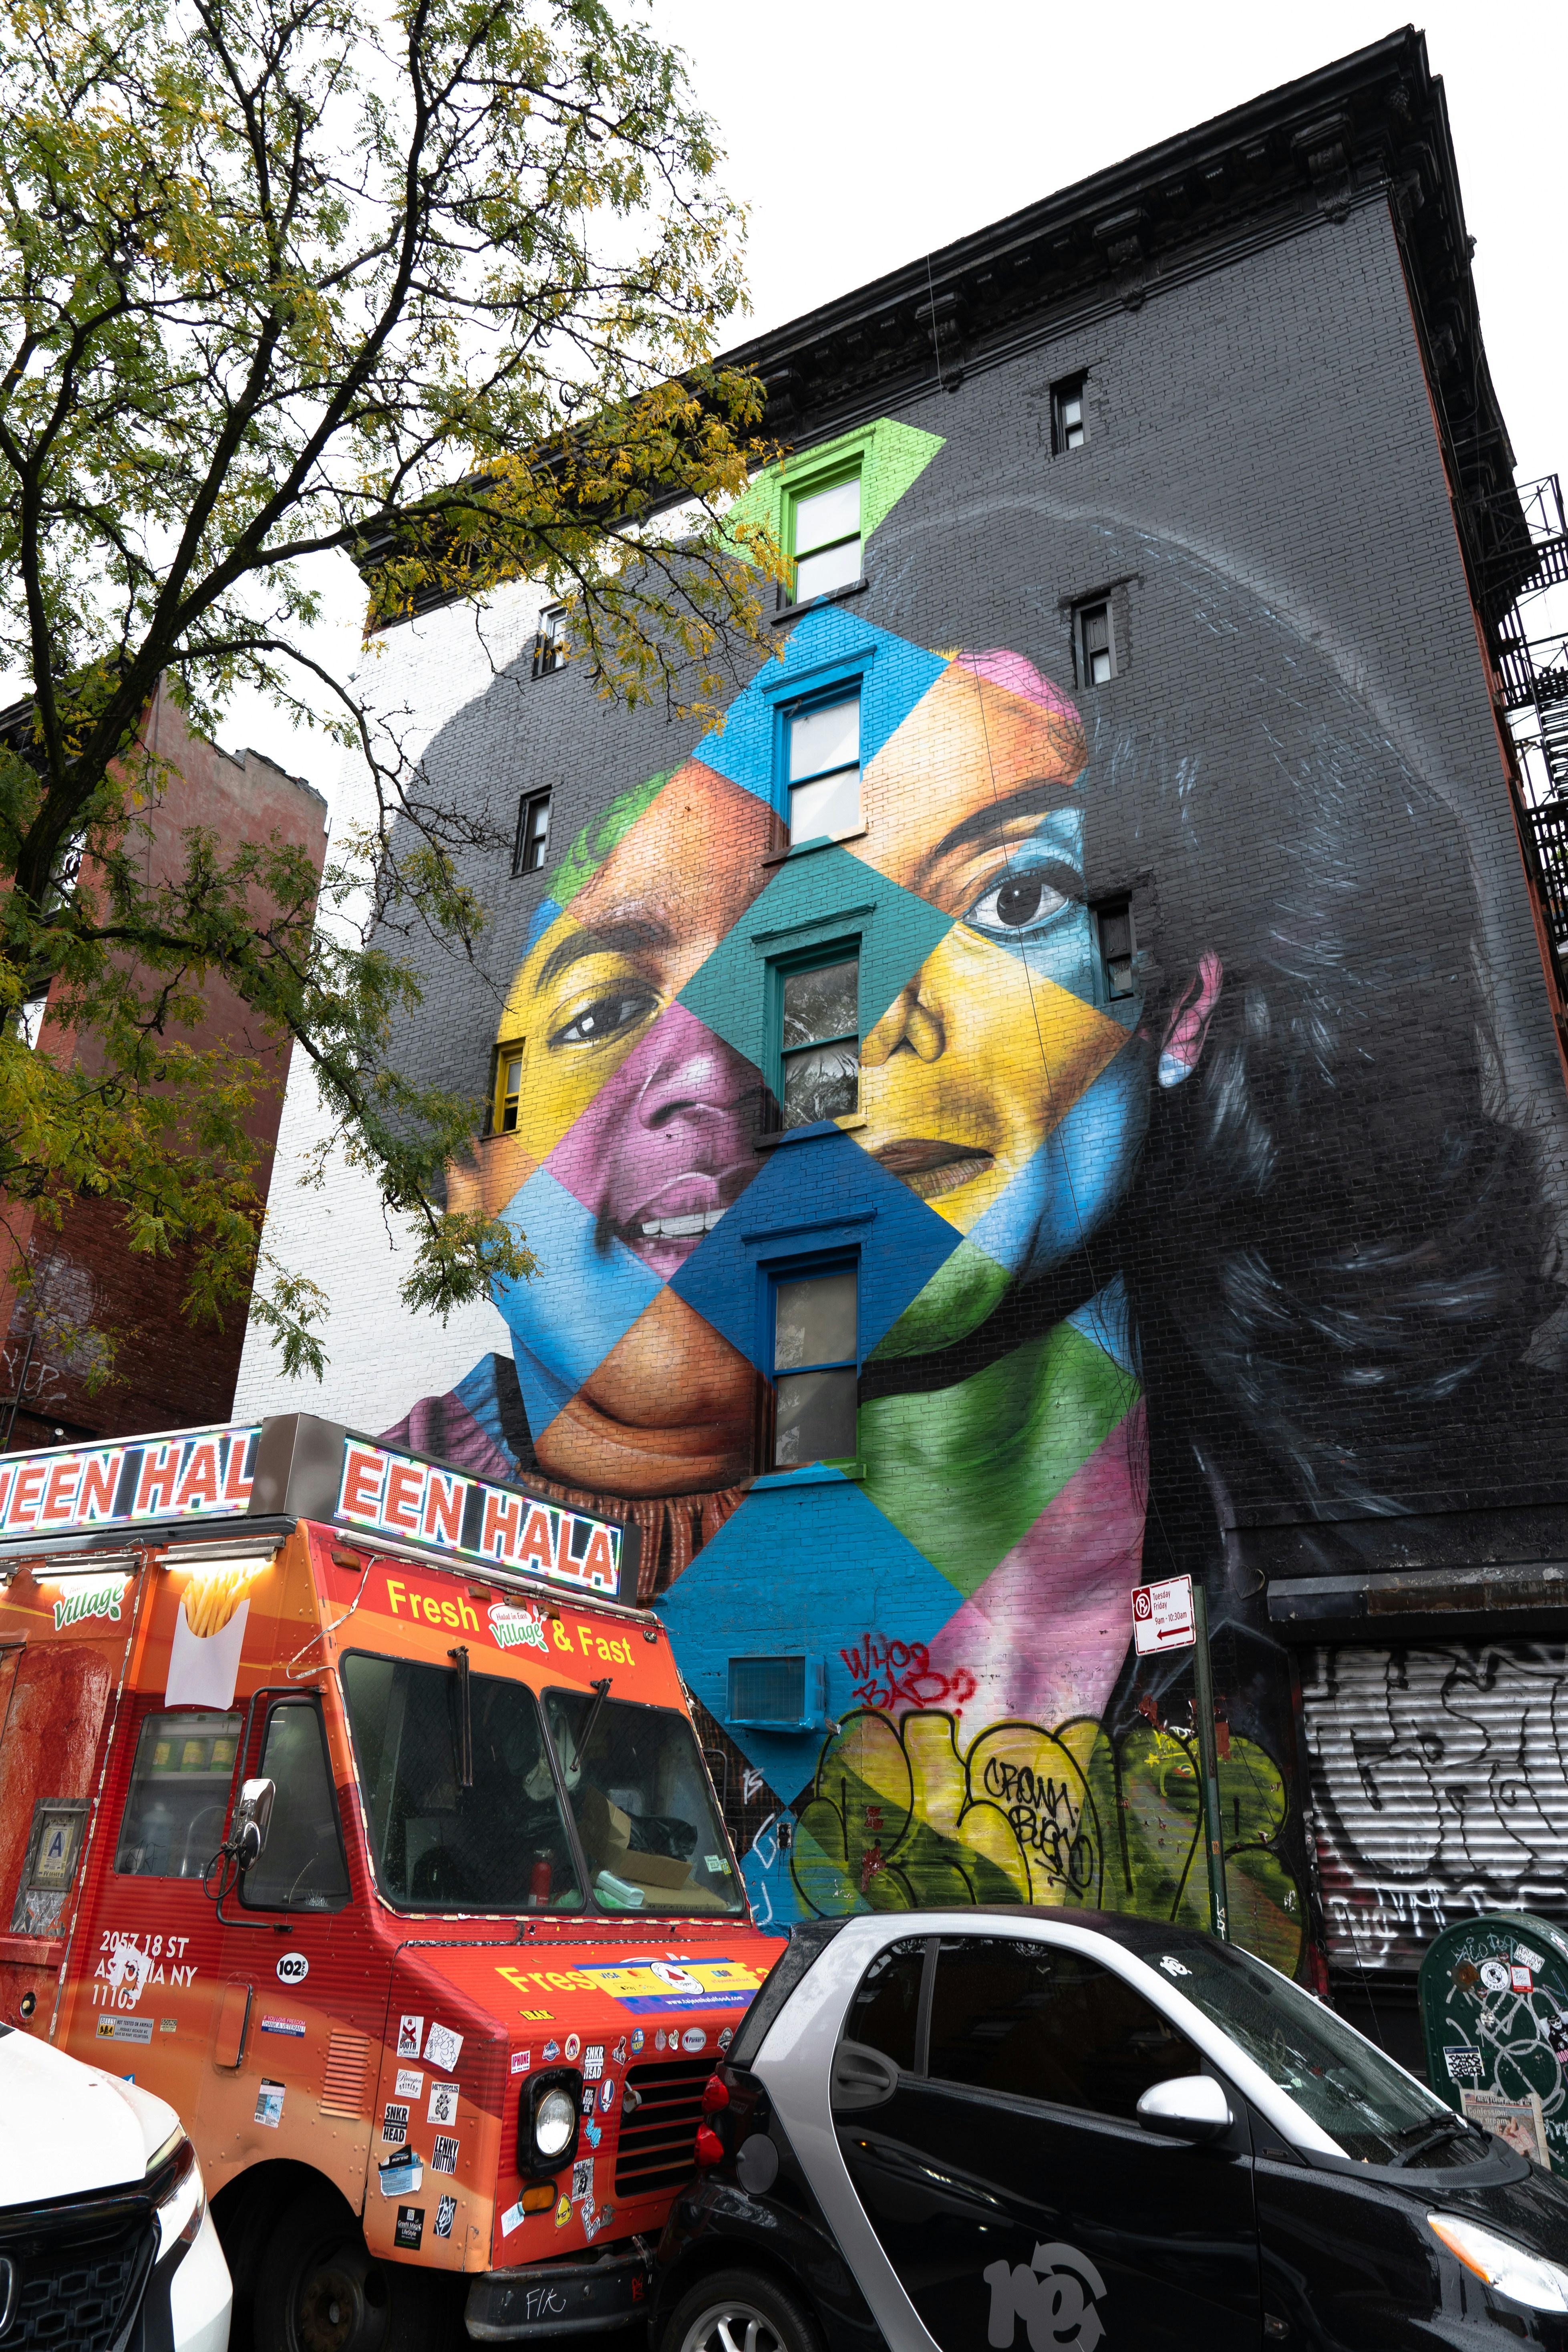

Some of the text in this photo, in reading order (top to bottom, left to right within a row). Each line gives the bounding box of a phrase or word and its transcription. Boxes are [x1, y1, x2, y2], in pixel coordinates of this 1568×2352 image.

[342, 1450, 614, 1585] EEN HALA
[1153, 1591, 1171, 1601] Tuesday
[56, 1583, 123, 1628] Village
[1153, 1602, 1167, 1611] Friday
[386, 1579, 635, 1666] Fresh & Fast
[1168, 1612, 1187, 1622] 10:30am
[491, 1623, 542, 1645] Village
[48, 1831, 61, 1857] A
[99, 1930, 189, 1958] 2057 18 ST
[279, 1960, 302, 1976] 102
[170, 1964, 198, 1988] NY
[665, 1996, 744, 2005] www.tajeenhalalfood.com
[586, 2046, 604, 2059] SNKR
[512, 2053, 529, 2067] IPHONE
[583, 2067, 602, 2080] HEAD
[432, 2083, 459, 2093] METROPOLIS
[585, 2089, 594, 2098] NYC
[583, 2097, 594, 2106] KUSH
[1477, 2095, 1489, 2103] NEW
[1490, 2096, 1504, 2104] YORK
[386, 2106, 408, 2121] SNKR
[383, 2127, 405, 2143] HEAD
[434, 2135, 459, 2156] LENNY
[392, 2155, 409, 2163] marine
[432, 2151, 457, 2173] VUITTON
